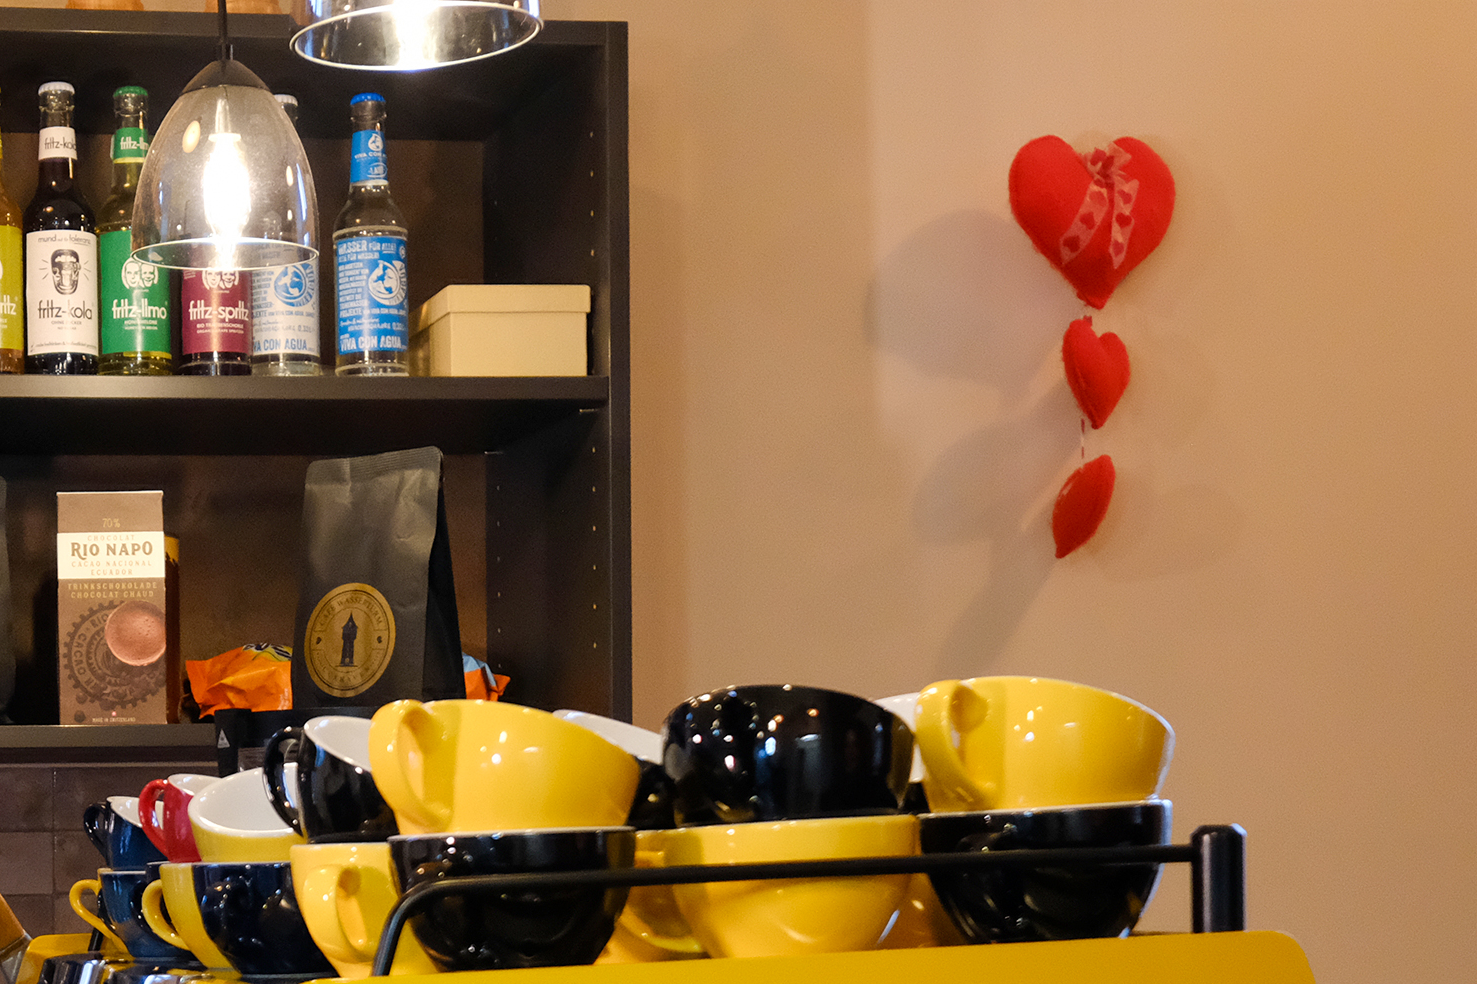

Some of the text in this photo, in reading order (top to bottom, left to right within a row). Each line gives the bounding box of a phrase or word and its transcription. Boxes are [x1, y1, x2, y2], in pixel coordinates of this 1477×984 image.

[38, 300, 92, 319] fritz-kola
[112, 298, 167, 319] fritz-limo
[189, 300, 249, 322] fritz-spritz
[264, 339, 281, 351] CON
[284, 338, 307, 350] AGUA
[358, 336, 378, 349] CON
[380, 335, 402, 348] AGUA
[102, 518, 121, 528] 70%
[87, 534, 135, 542] CHOCOLAT
[70, 541, 153, 561] RIO NAPO
[67, 582, 158, 590] TRINKSCHOKOLADE
[70, 590, 154, 599] CHOCOLAT CHAUD
